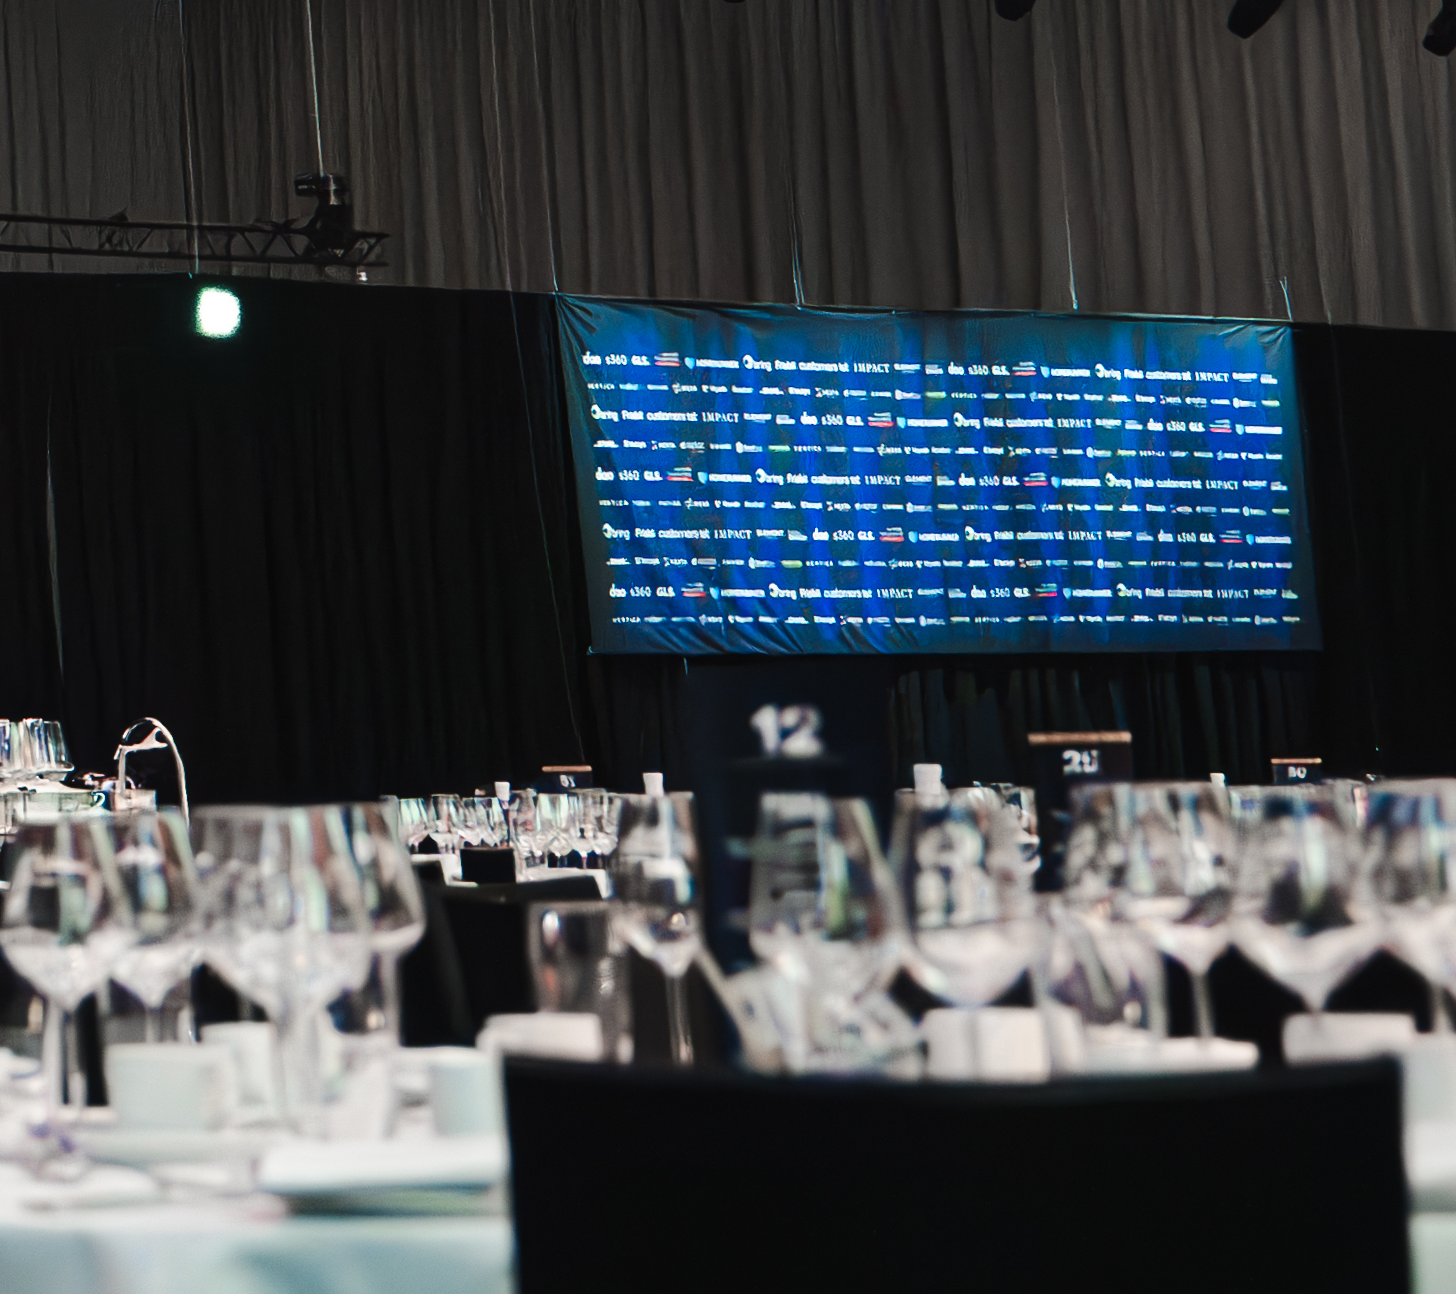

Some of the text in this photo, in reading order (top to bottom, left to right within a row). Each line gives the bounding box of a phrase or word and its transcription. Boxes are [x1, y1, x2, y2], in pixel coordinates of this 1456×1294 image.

[853, 363, 890, 373] IMPACT
[1194, 371, 1229, 383] IMPACT
[702, 411, 739, 423] IMPACT
[1057, 418, 1092, 429] IMPACT
[864, 474, 901, 486] IMPACT
[1205, 479, 1238, 491] IMPACT
[714, 529, 752, 540] IMPACT
[877, 588, 913, 599] IMPACT
[749, 703, 823, 759] 12
